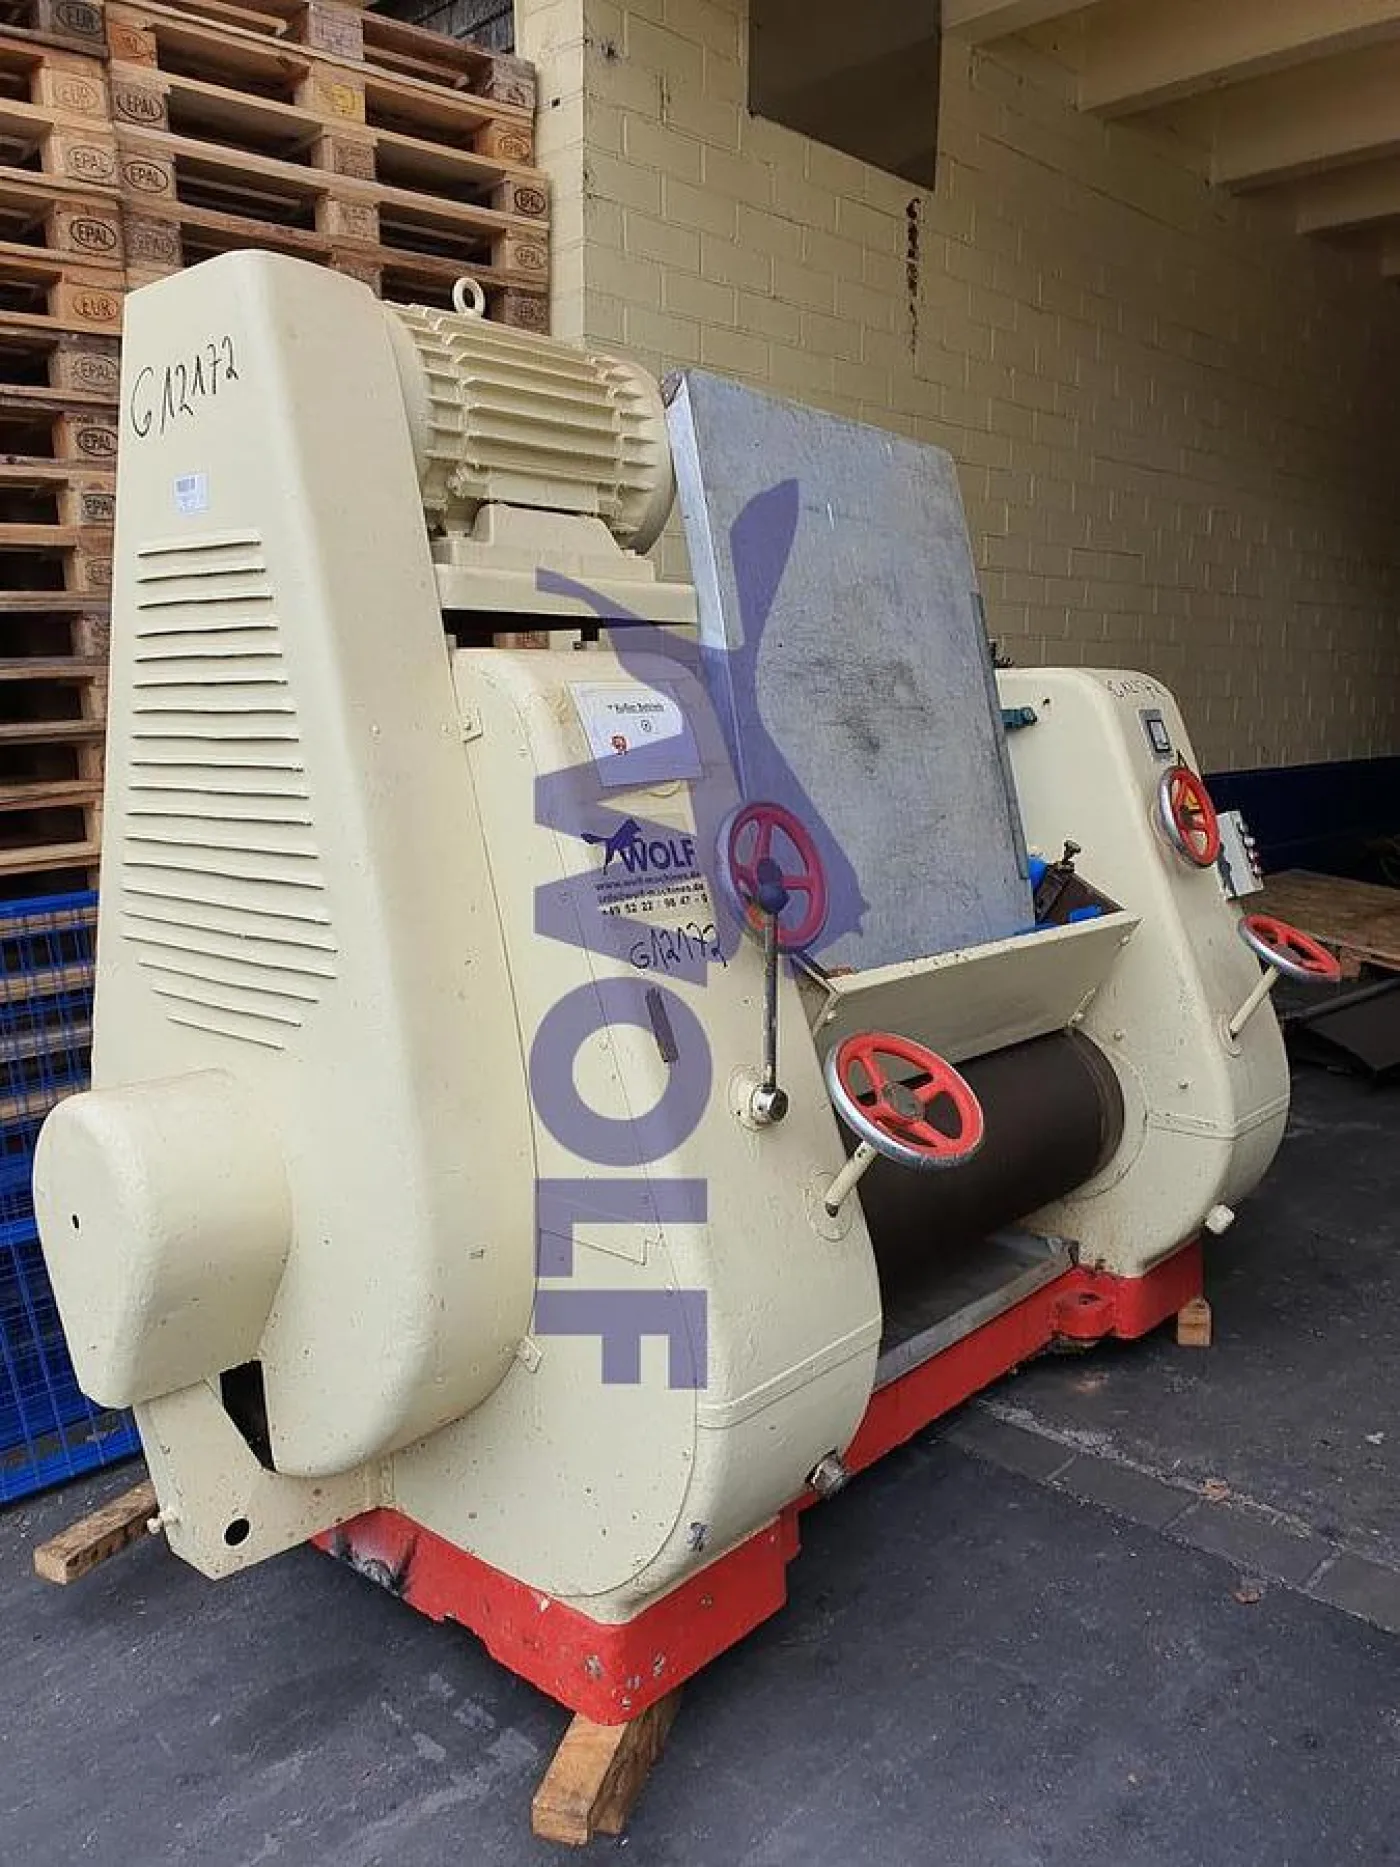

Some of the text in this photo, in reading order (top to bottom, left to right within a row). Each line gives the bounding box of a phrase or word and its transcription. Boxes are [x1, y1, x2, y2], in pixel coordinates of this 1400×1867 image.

[130, 166, 161, 188] EPAL
[77, 223, 110, 246] EPAL
[81, 298, 114, 317] EUR
[81, 362, 115, 381] EPAL
[82, 431, 112, 450] EPAL
[619, 838, 696, 873] WOLF
[629, 921, 728, 970] G12172
